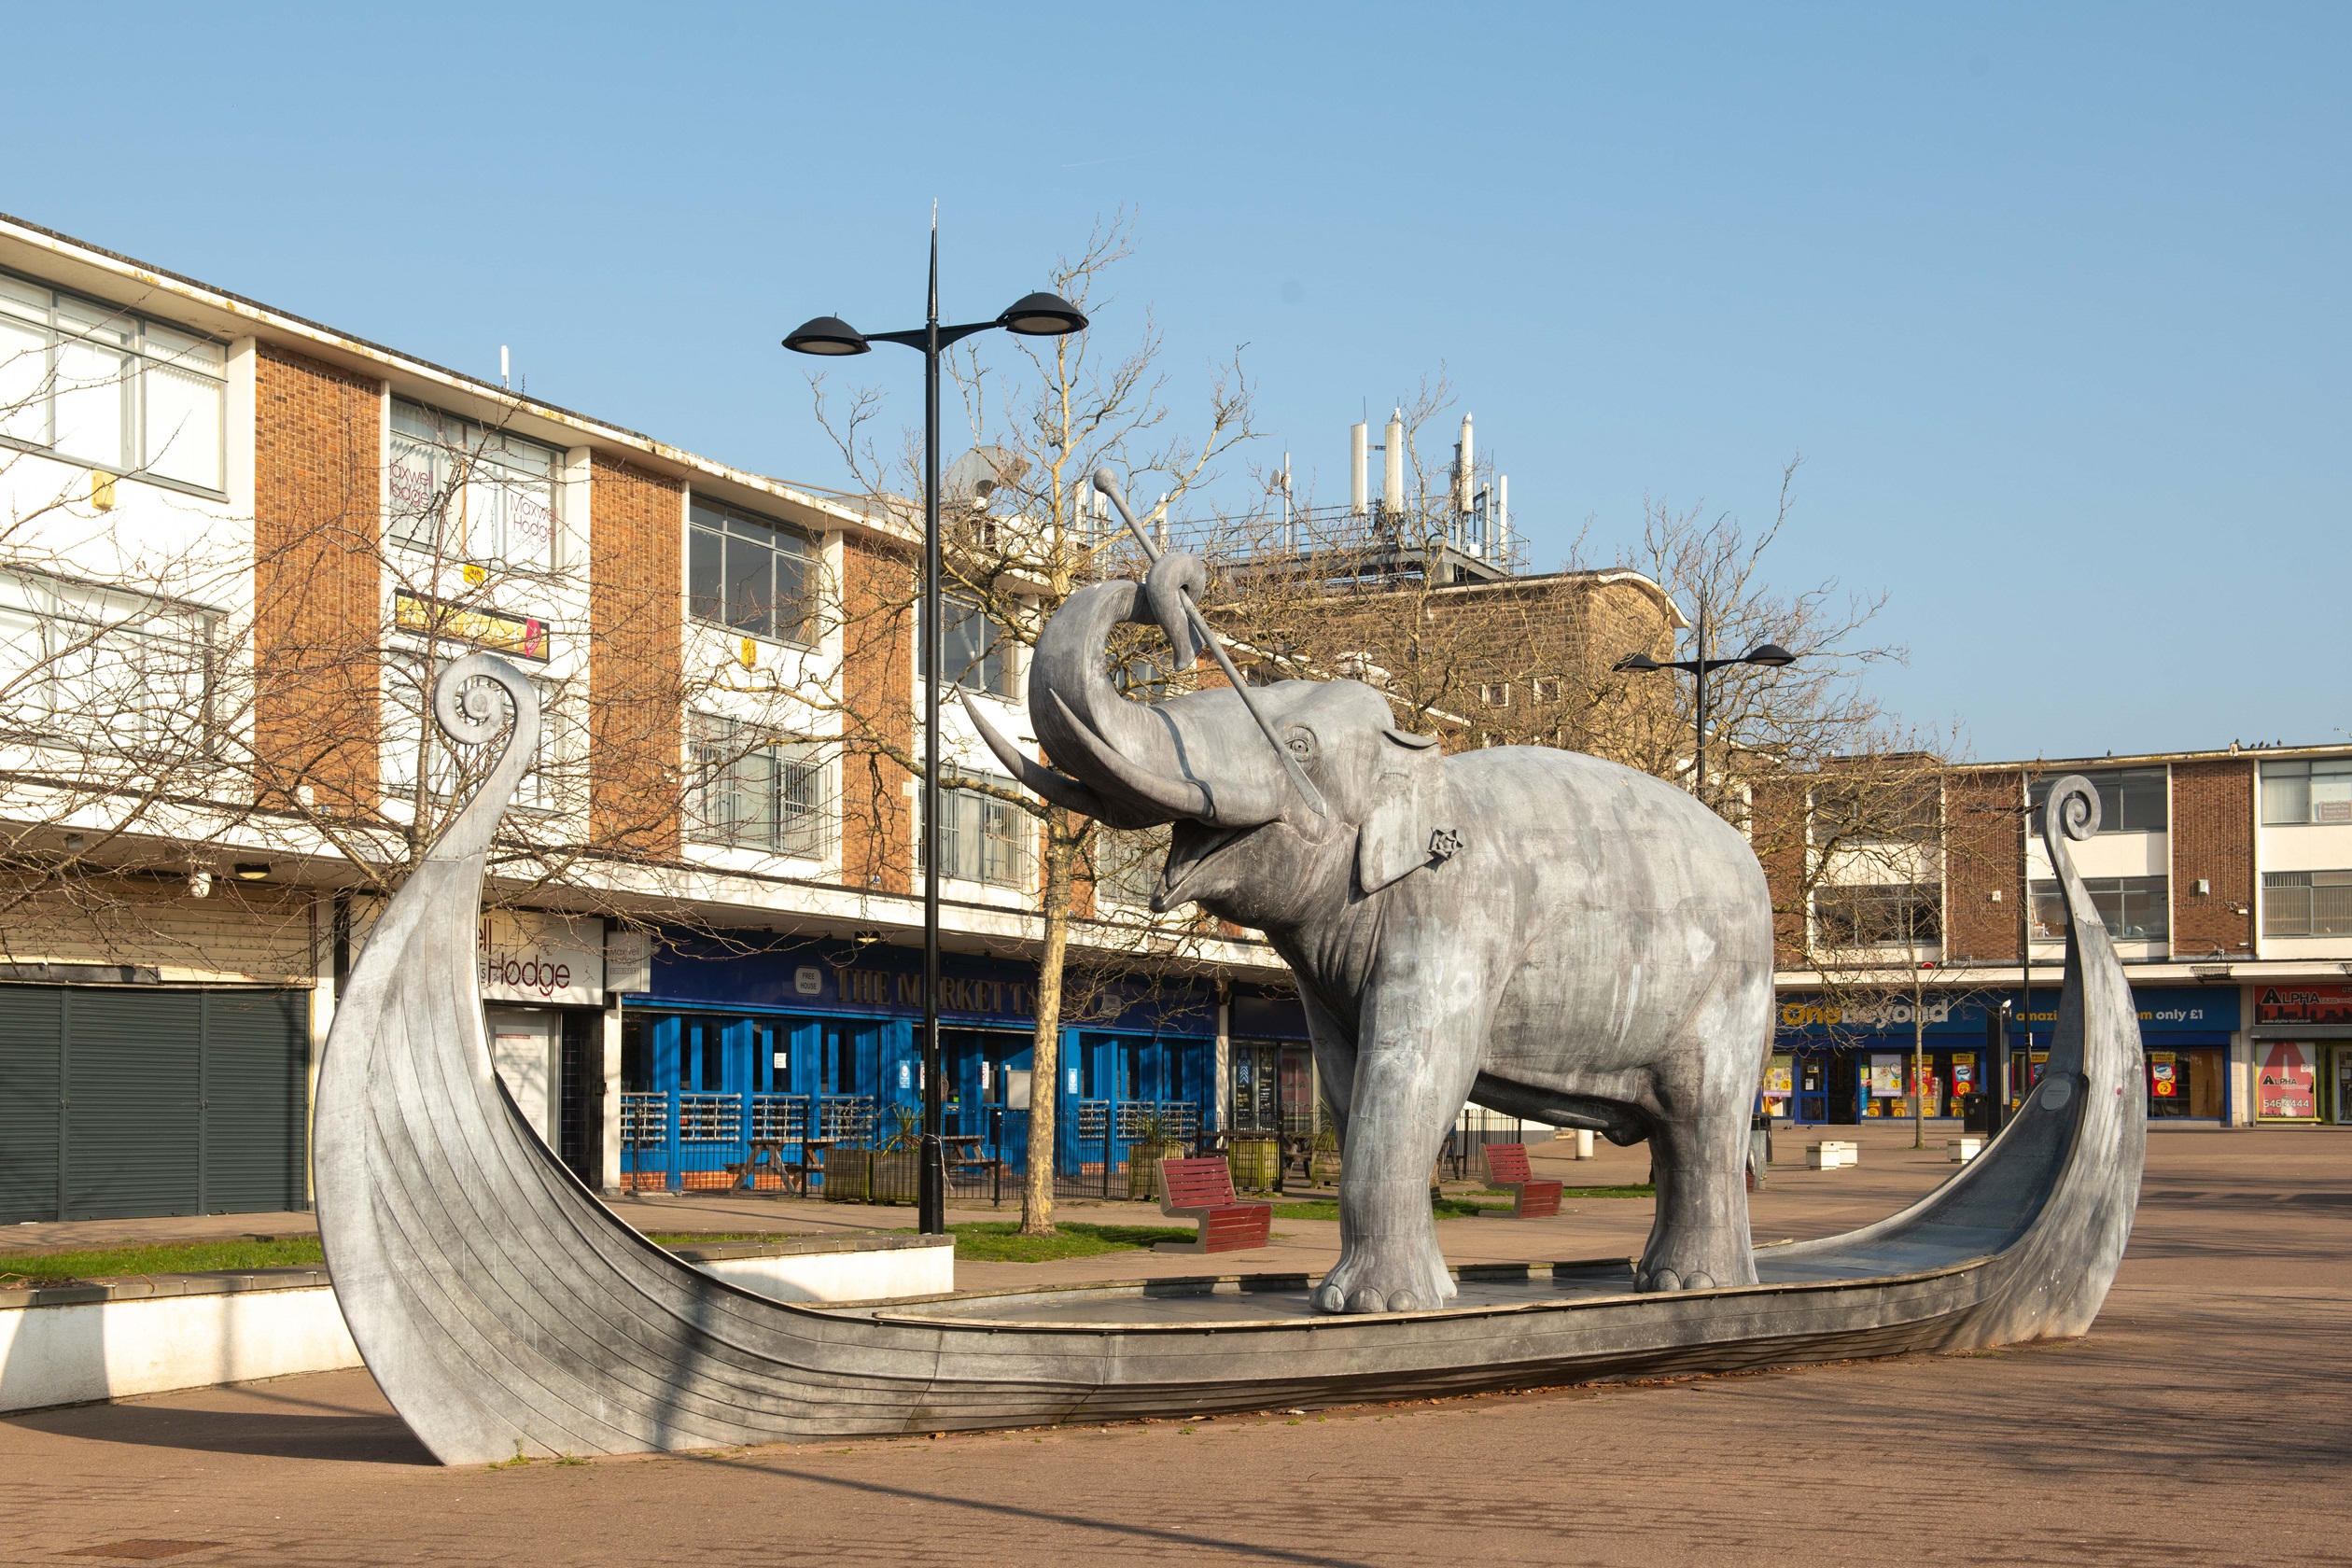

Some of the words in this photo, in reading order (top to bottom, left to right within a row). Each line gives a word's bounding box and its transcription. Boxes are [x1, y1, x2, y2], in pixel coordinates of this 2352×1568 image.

[510, 494, 559, 525] Maxwell
[514, 514, 556, 543] Hodge
[609, 947, 640, 956] Maxwell
[488, 952, 570, 997] Hodge
[802, 972, 815, 980] FREE
[800, 982, 817, 990] HOUSE
[833, 966, 891, 1005] THE
[897, 973, 1006, 1015] MRKET
[2261, 987, 2319, 1005] ALPHA
[2155, 1009, 2187, 1022] only
[2190, 1009, 2204, 1020] £1
[2261, 1075, 2298, 1085] ALPHA
